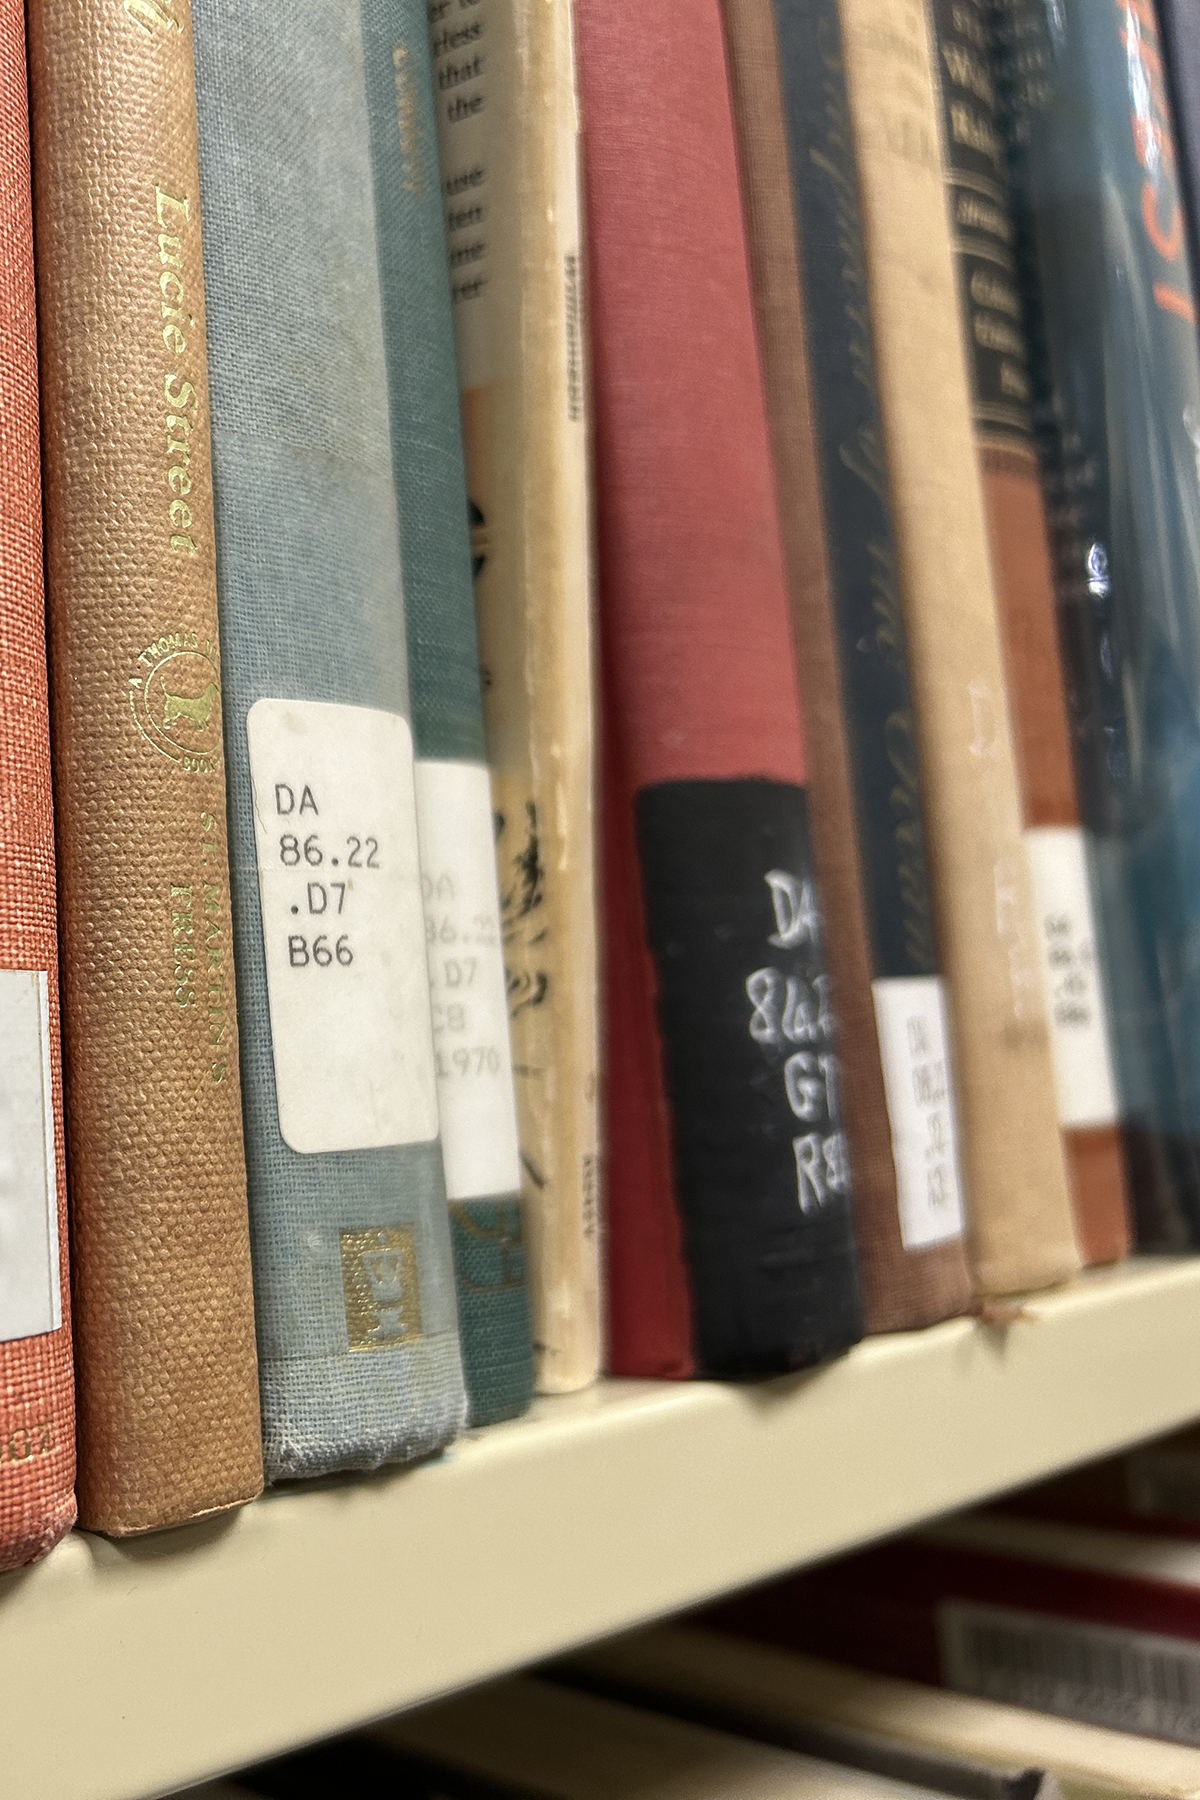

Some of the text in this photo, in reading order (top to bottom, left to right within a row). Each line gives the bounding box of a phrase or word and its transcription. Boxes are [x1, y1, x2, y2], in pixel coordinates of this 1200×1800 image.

[154, 184, 199, 558] Lucie Street
[138, 631, 199, 668] THOMAS
[274, 783, 320, 816] DA
[278, 833, 382, 870] 86.22
[290, 881, 347, 916] .D7
[170, 883, 198, 1011] PRESS
[199, 811, 230, 1085] ST. MARTIN'S
[287, 934, 355, 968] B66
